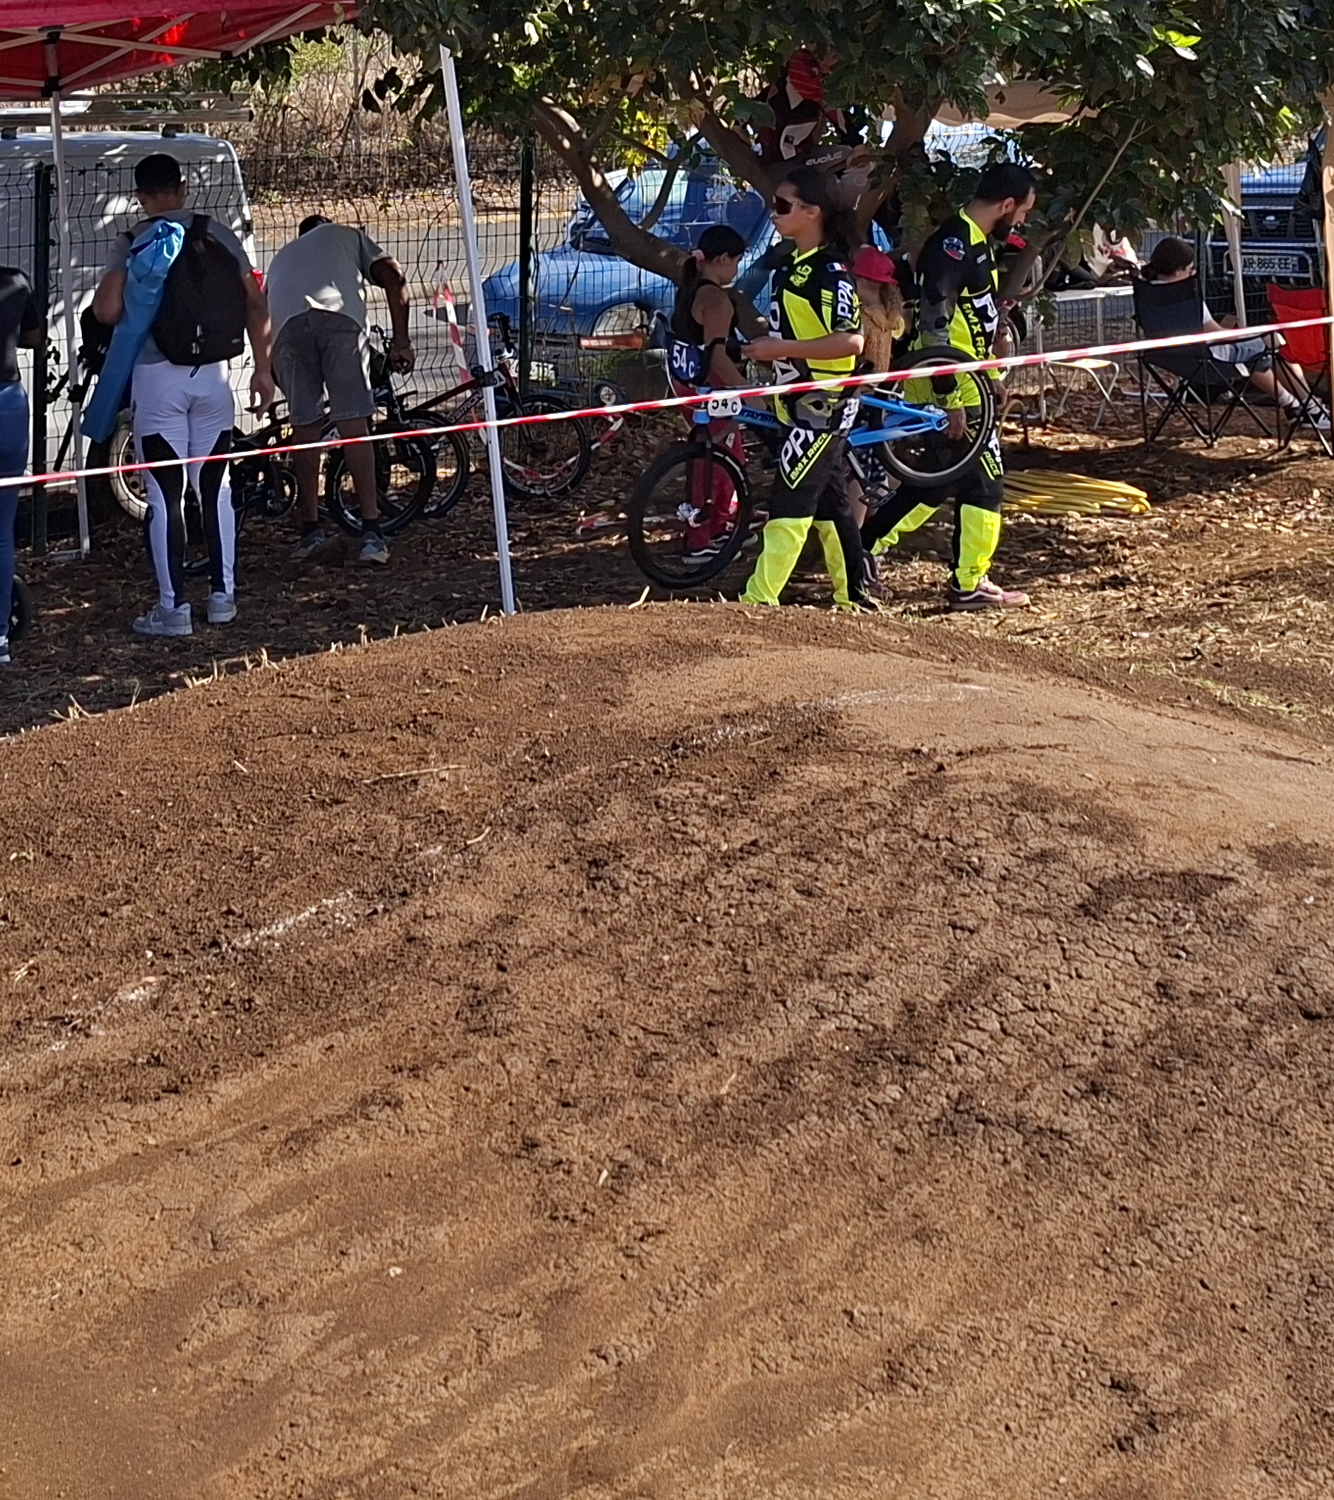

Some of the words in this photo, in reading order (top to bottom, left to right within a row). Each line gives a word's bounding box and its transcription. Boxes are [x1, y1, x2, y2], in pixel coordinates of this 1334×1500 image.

[837, 279, 854, 319] PPA
[672, 344, 688, 373] 54
[688, 360, 695, 379] C
[730, 401, 738, 414] C
[789, 456, 809, 481] BMX
